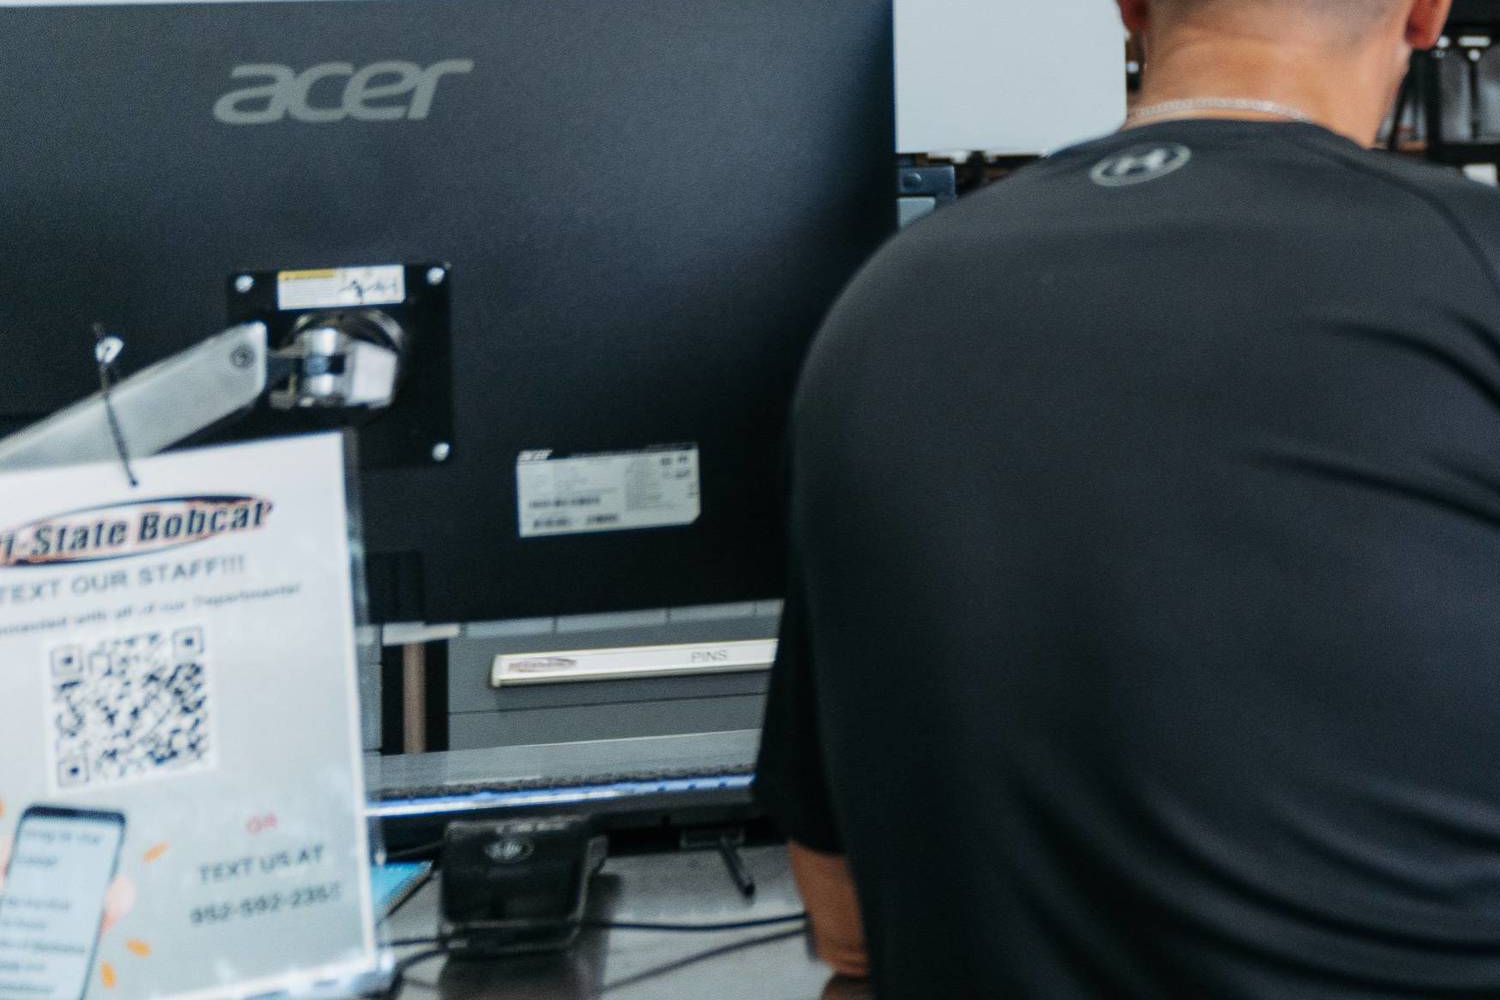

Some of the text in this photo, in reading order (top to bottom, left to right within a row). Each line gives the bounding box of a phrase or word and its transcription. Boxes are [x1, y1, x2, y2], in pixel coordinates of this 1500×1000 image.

[212, 58, 475, 125] acer
[0, 500, 272, 558] i-State Bobcat
[72, 569, 128, 594] OUR
[138, 554, 246, 586] STAFF!!!
[690, 650, 728, 663] PINS
[199, 844, 324, 885] TEXT US AT
